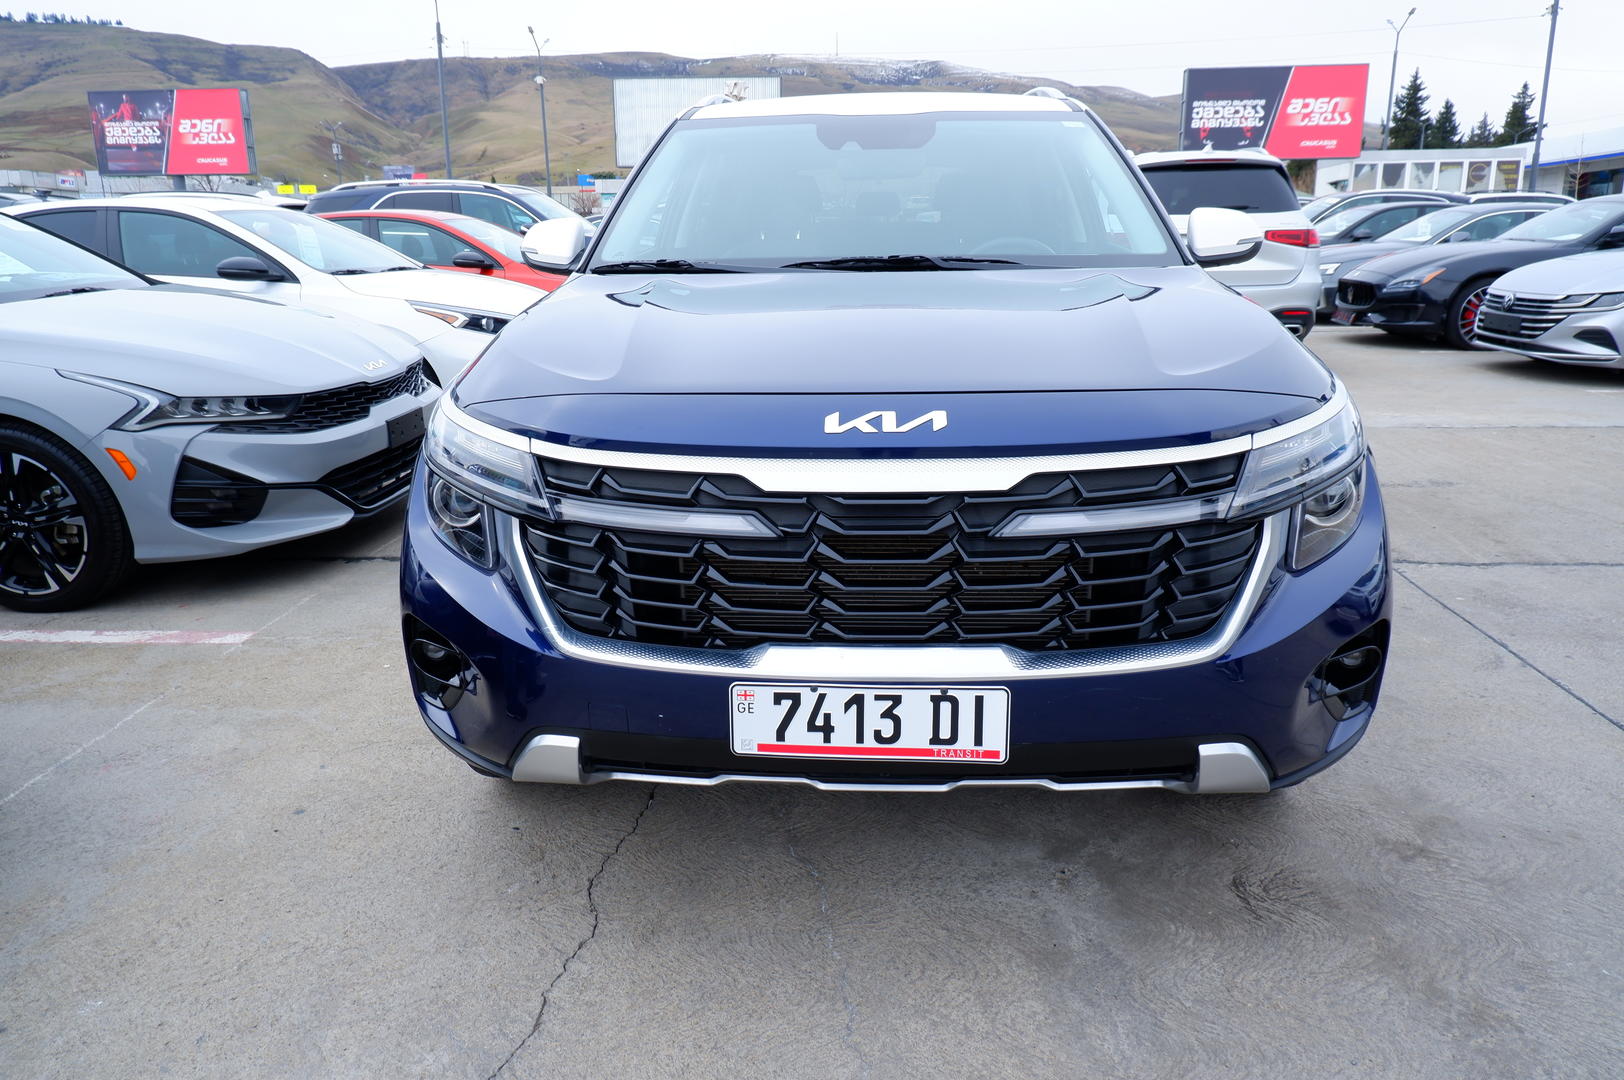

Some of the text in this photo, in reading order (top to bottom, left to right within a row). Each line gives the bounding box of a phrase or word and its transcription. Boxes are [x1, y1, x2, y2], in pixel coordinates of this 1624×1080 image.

[824, 410, 948, 434] KIA
[737, 702, 755, 714] GE
[773, 691, 984, 747] 7413 DI
[932, 748, 985, 759] TRANSIT
